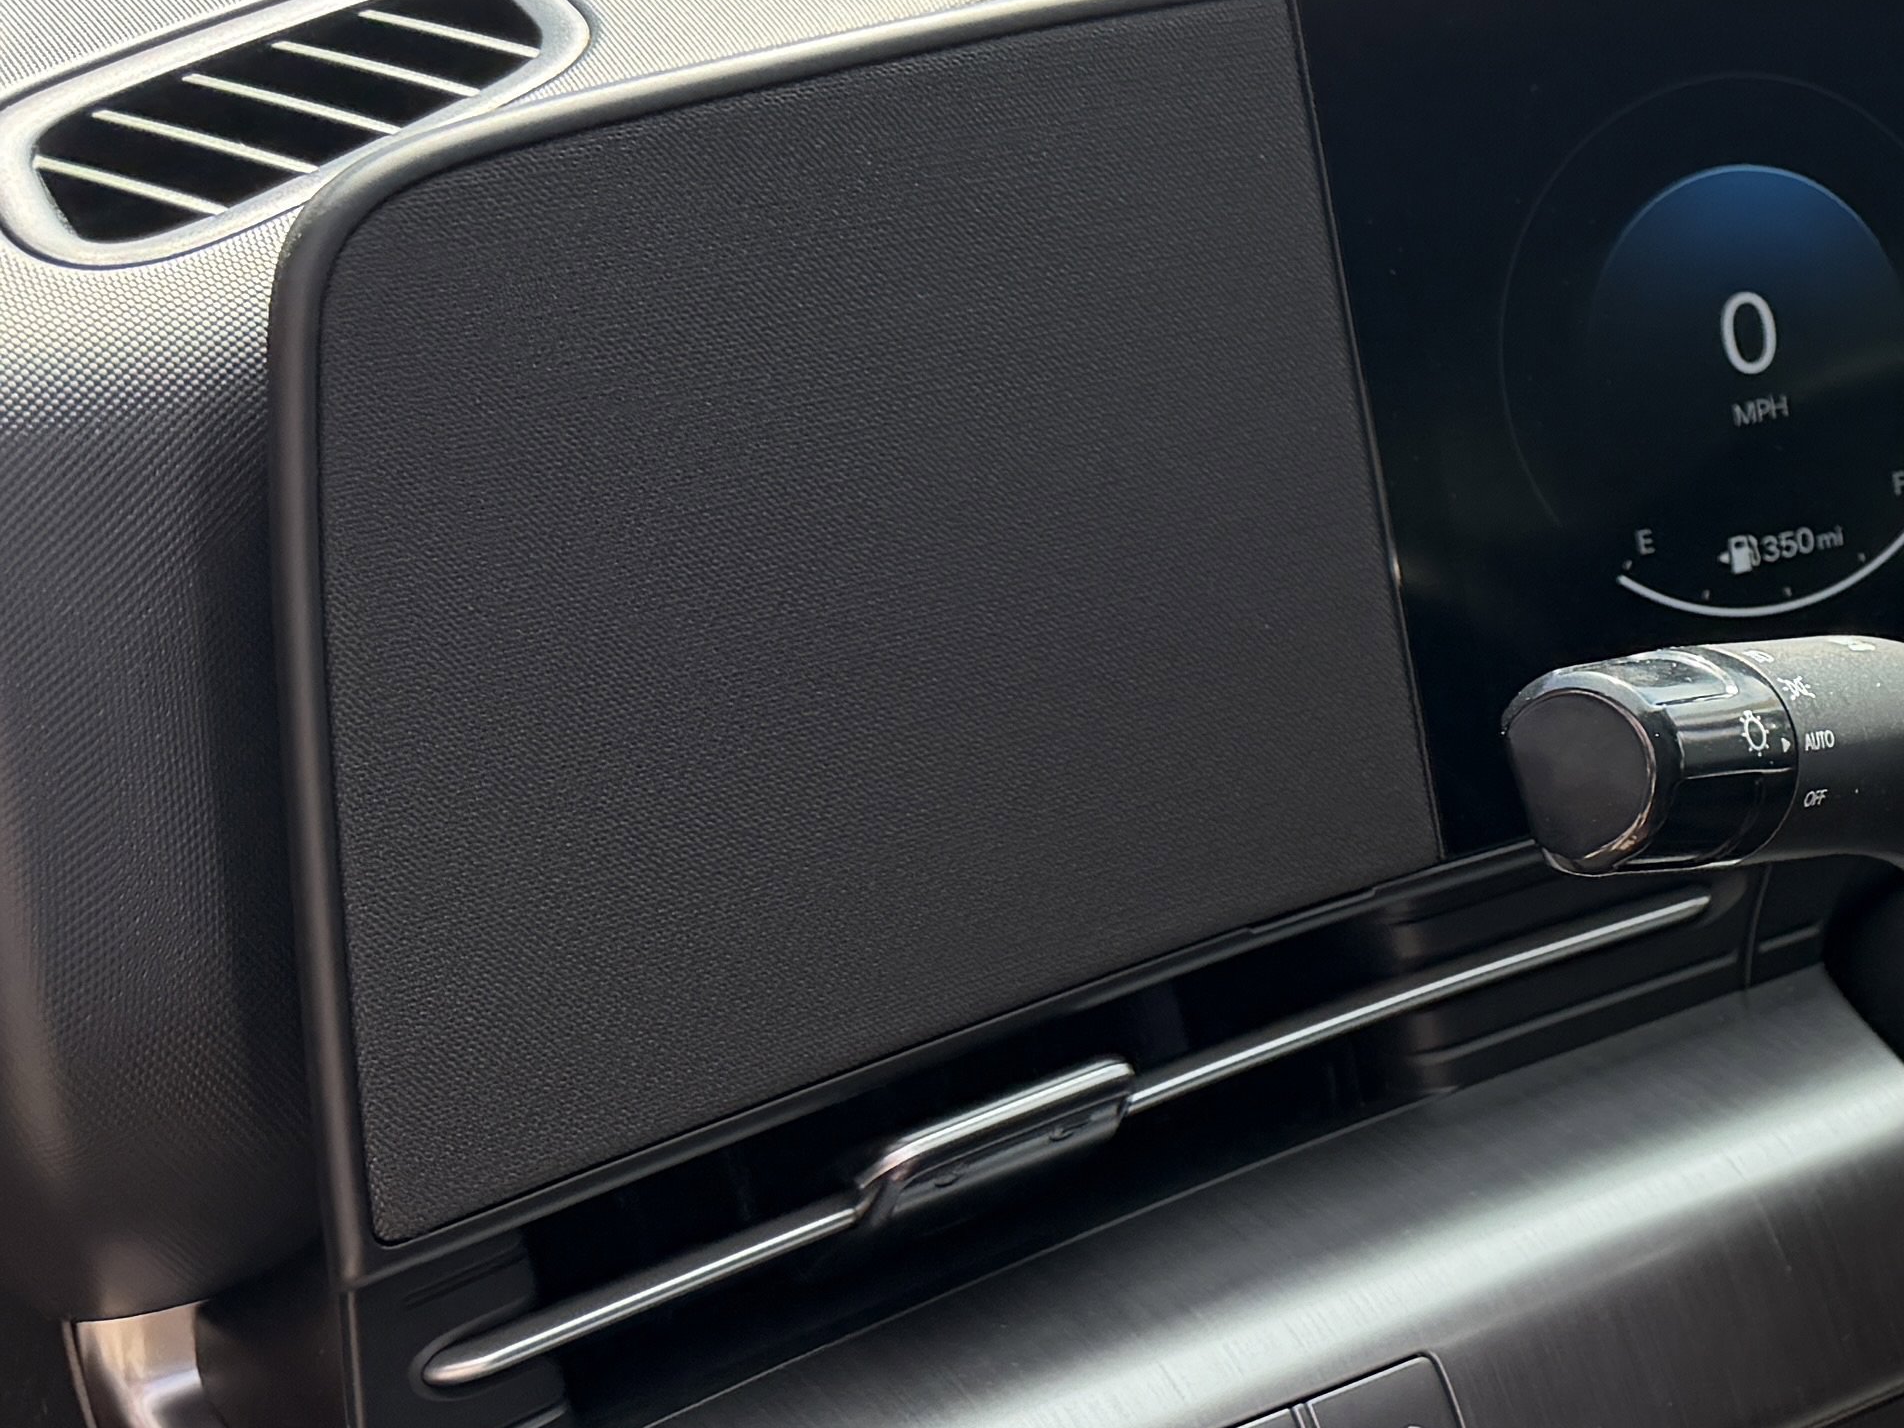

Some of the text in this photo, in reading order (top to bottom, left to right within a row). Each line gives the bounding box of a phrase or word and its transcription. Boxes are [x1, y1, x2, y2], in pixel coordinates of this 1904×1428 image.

[1720, 291, 1777, 374] 0
[1732, 393, 1789, 427] MPH
[1635, 528, 1656, 556] E
[1804, 729, 1836, 752] AUTO
[1803, 788, 1829, 808] OFF
